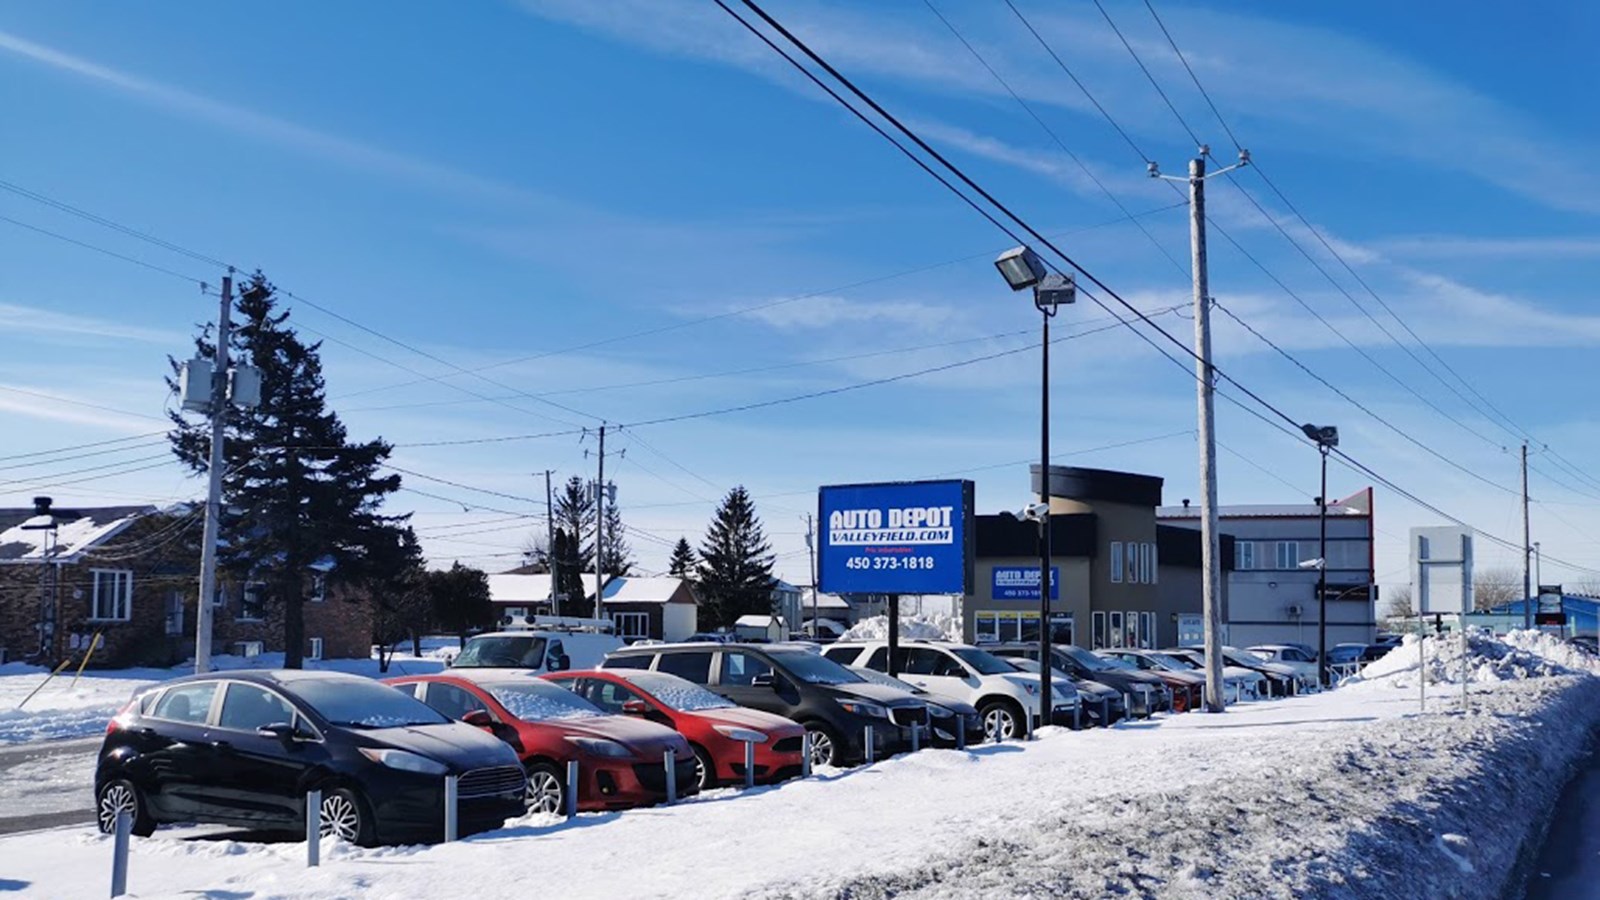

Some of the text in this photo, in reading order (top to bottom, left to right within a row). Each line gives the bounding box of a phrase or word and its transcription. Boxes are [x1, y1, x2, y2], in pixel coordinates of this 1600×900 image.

[829, 506, 953, 529] AUTO DEPOT
[832, 530, 949, 542] VALLEYFIELD.COM
[846, 556, 934, 569] 450 373-1818
[996, 570, 1022, 580] AUTO
